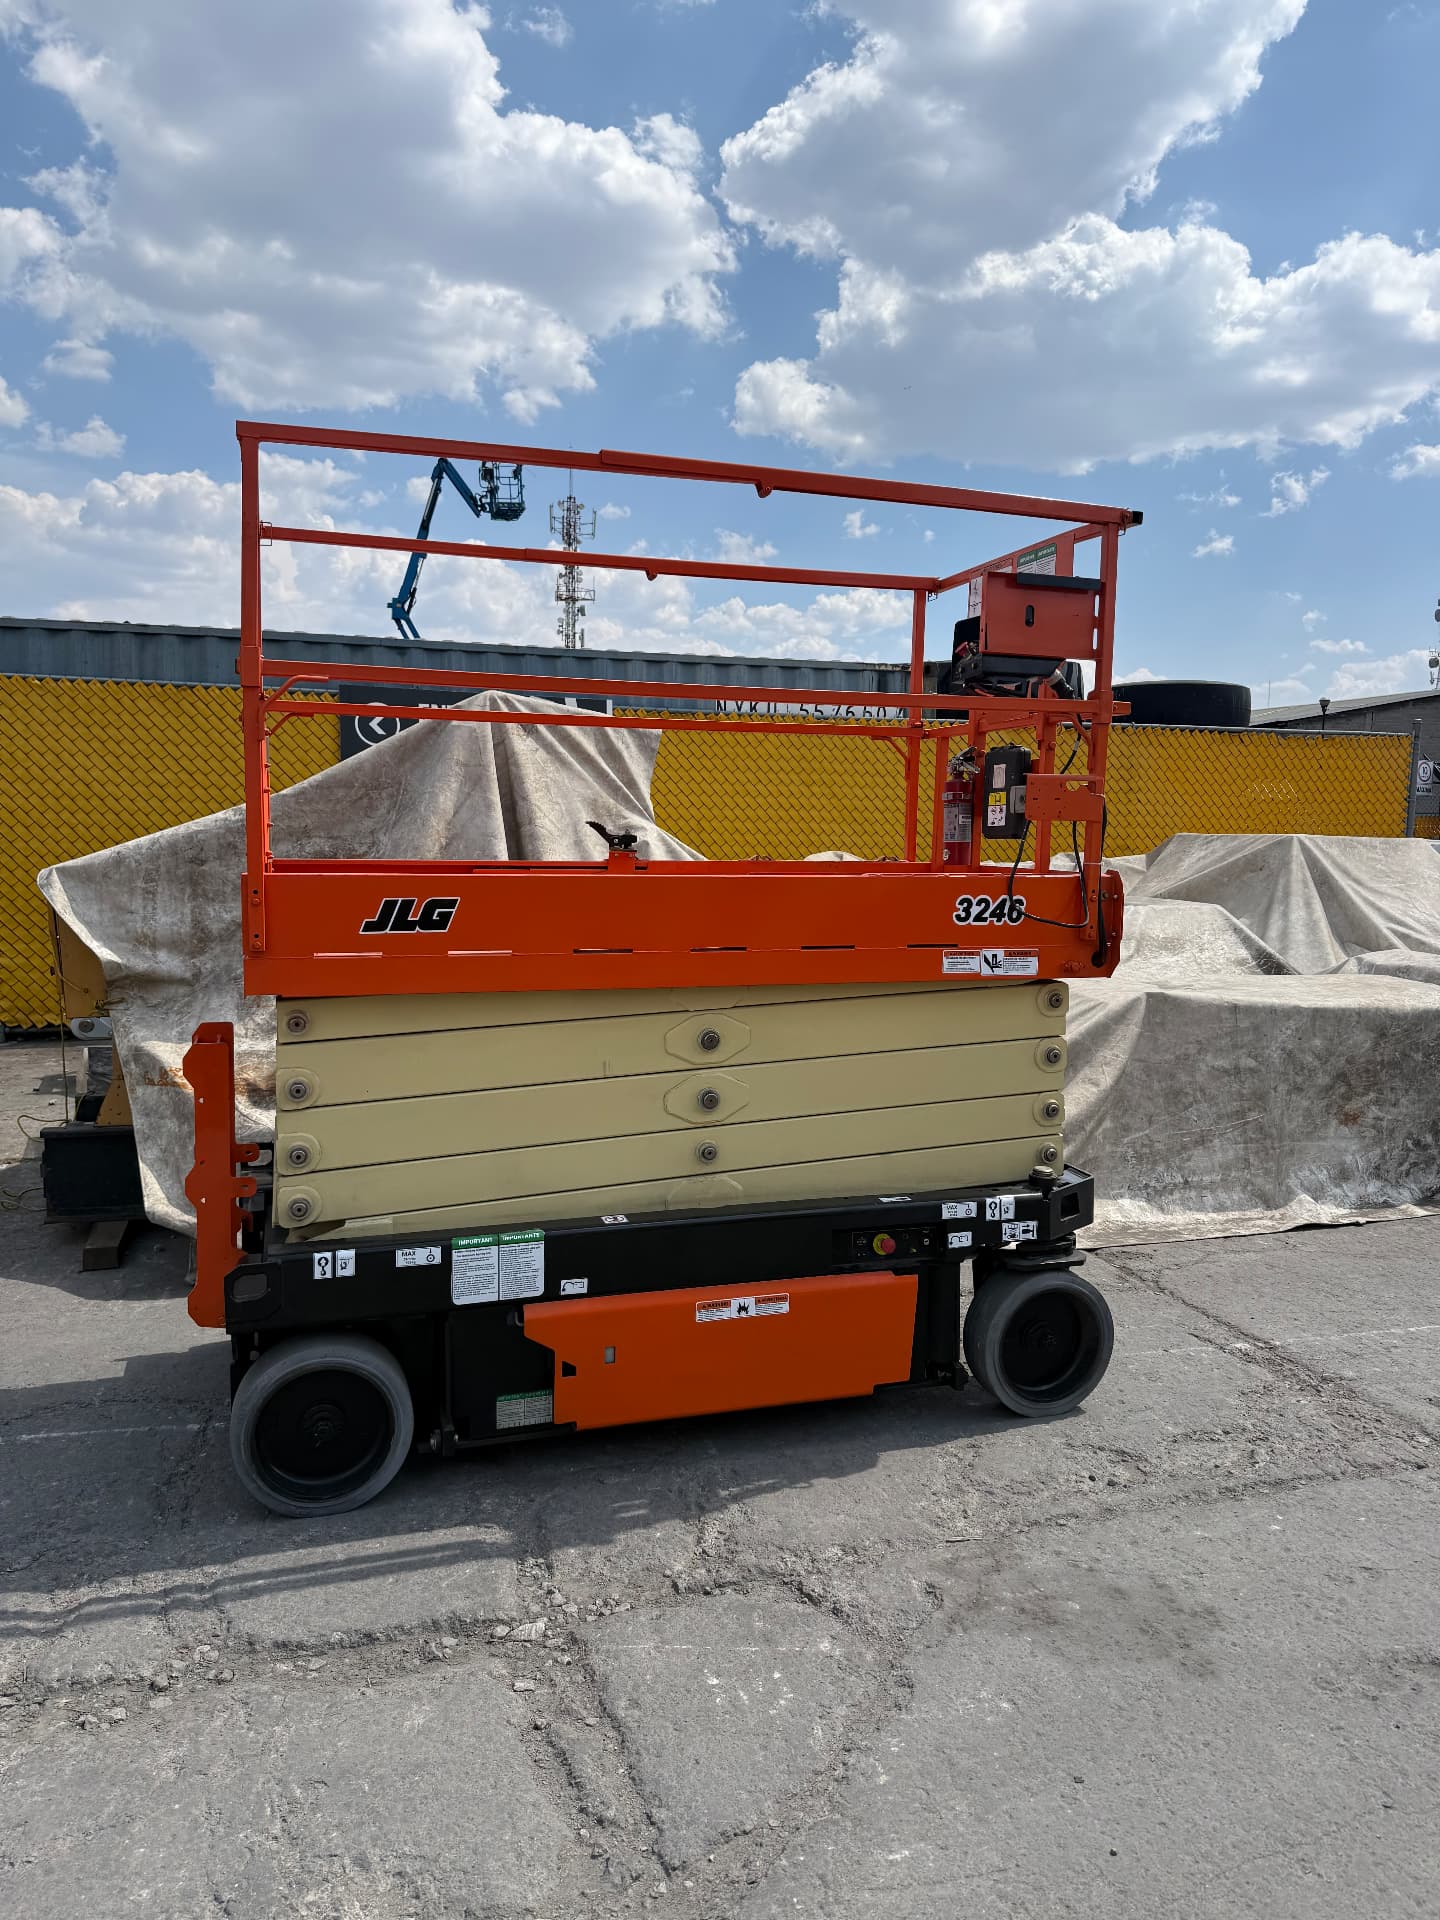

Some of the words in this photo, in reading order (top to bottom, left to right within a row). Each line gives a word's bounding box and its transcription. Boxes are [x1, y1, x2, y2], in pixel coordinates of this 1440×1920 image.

[359, 897, 460, 934] JLG
[953, 895, 1026, 925] 3246
[458, 1237, 493, 1246] IMPORTANT
